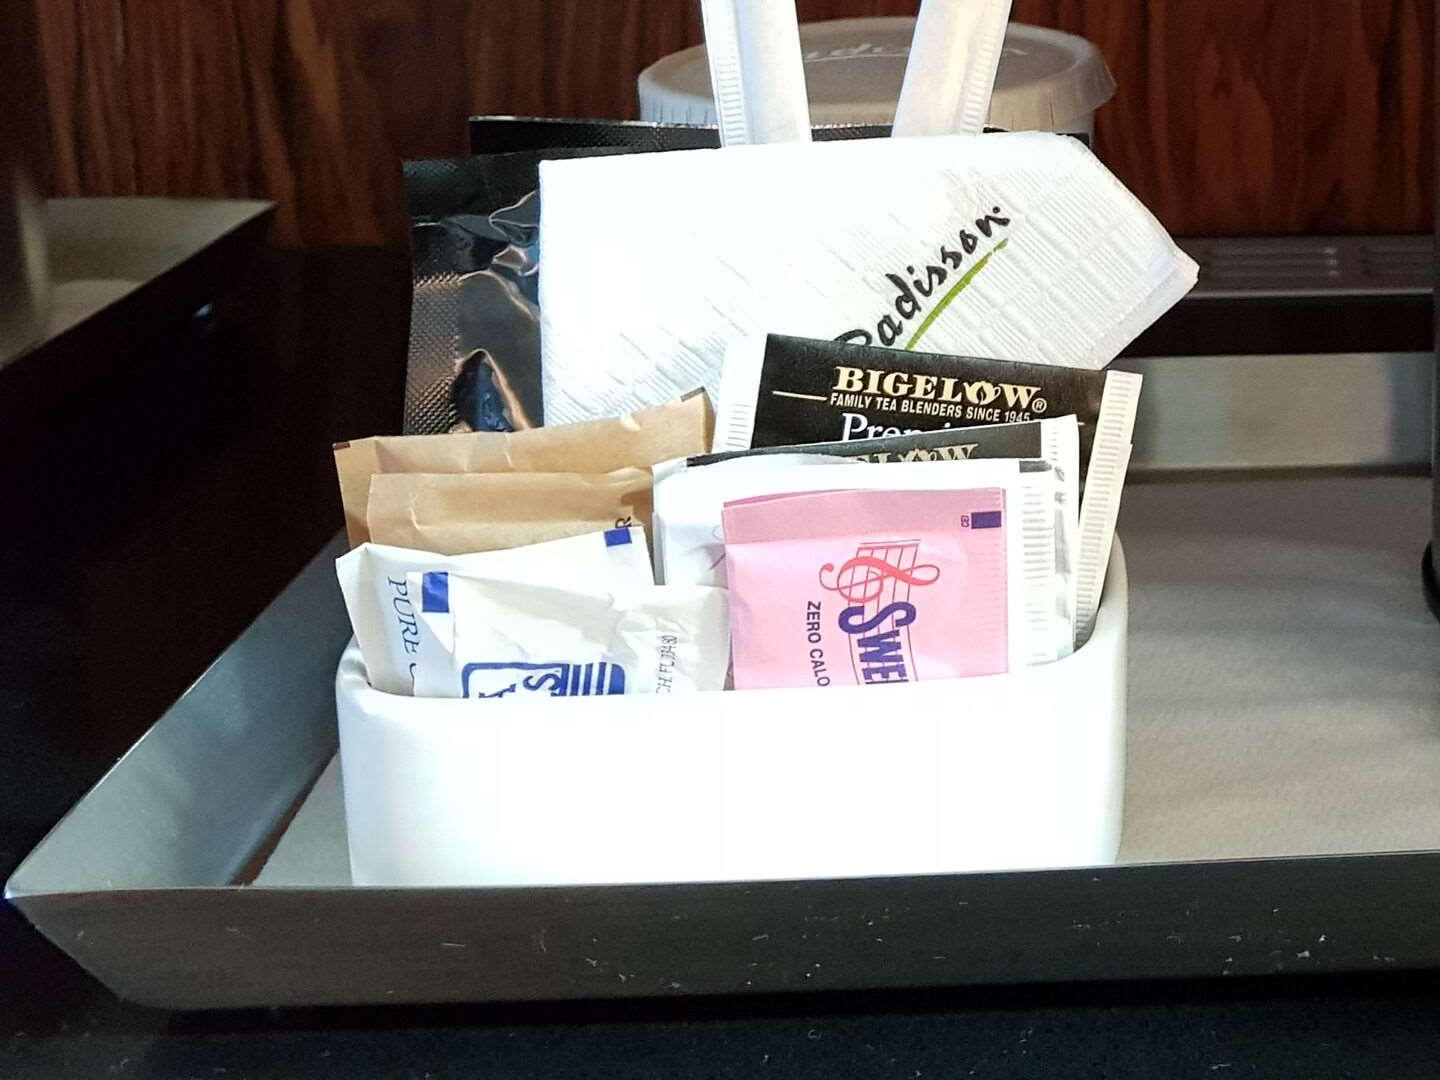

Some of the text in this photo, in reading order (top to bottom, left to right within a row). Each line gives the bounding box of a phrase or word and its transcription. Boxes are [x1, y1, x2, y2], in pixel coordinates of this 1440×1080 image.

[830, 392, 872, 409] FAMILY
[875, 396, 897, 411] TEA
[901, 400, 962, 418] BLENDERS
[966, 406, 1001, 422] SINCE
[388, 575, 421, 654] PURE
[806, 600, 822, 644] ZERO
[838, 601, 917, 685] SWE
